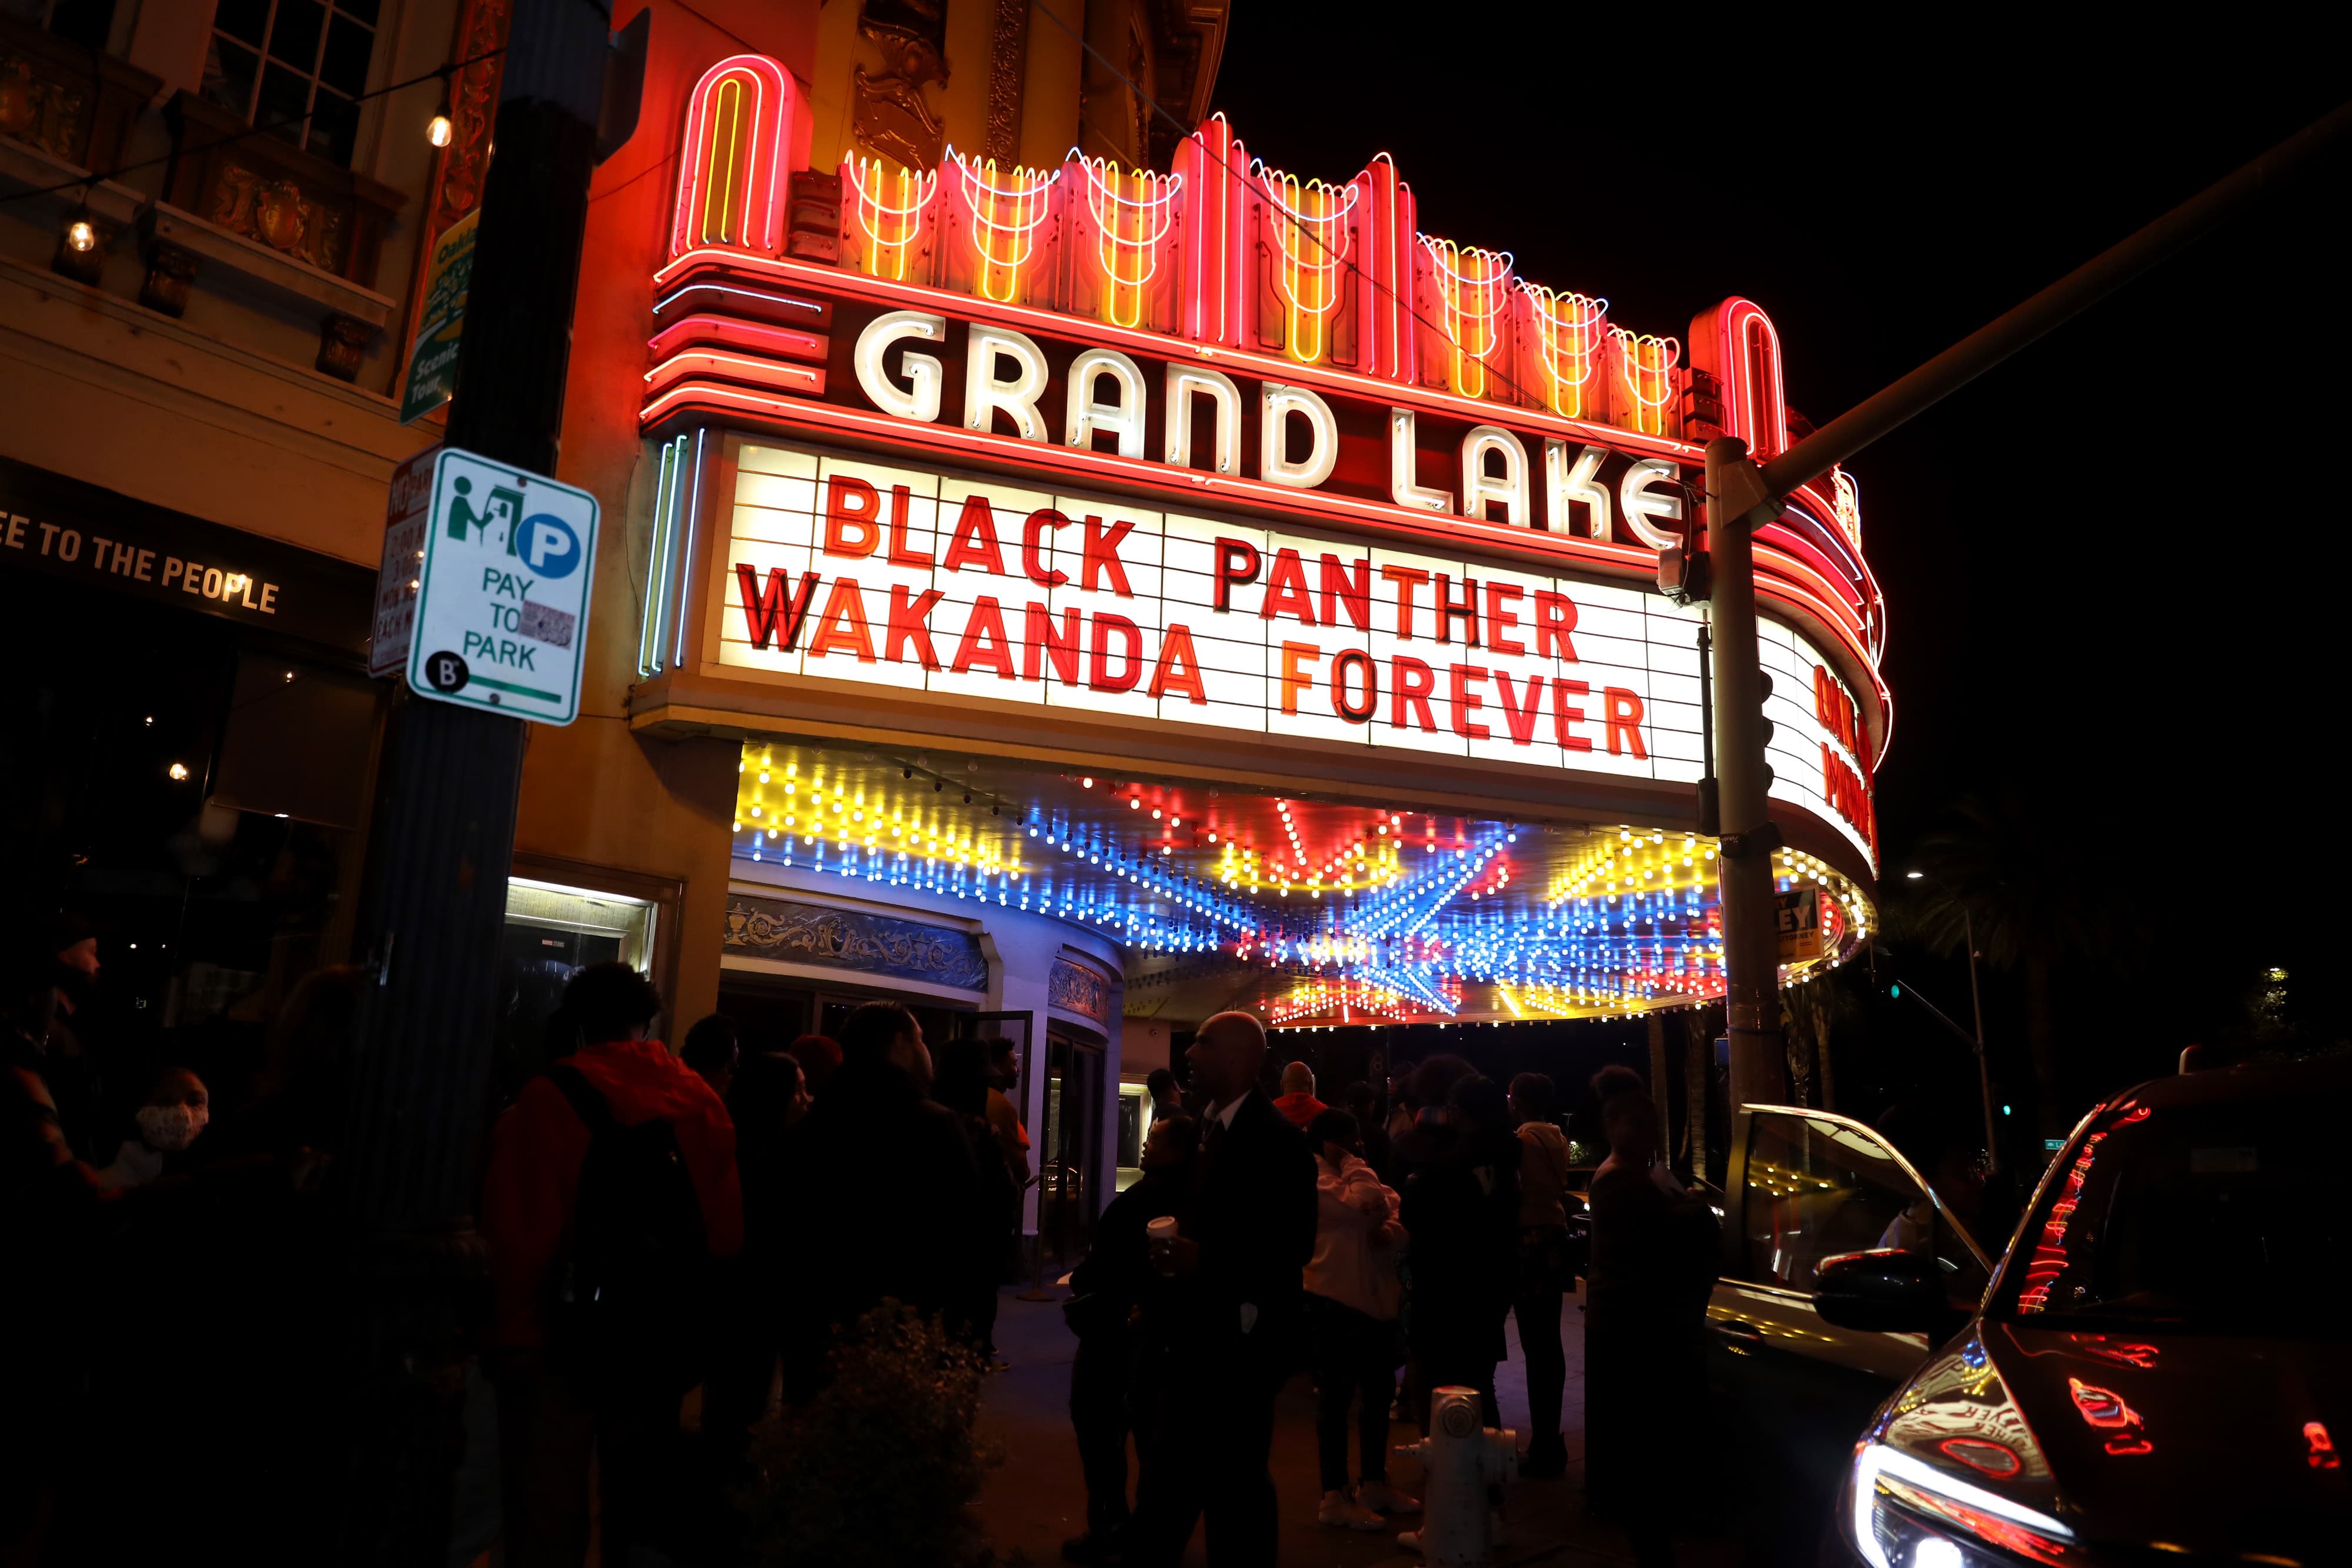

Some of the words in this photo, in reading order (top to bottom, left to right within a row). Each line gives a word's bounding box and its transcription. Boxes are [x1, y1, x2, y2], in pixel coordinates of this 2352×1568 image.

[415, 342, 461, 380] Scenic
[411, 375, 442, 404] Tour
[854, 310, 1338, 487] GRAND
[1391, 406, 1683, 550] LAKE
[530, 521, 572, 569] P
[39, 521, 81, 563] TO
[92, 536, 156, 583] THE
[161, 555, 280, 615] PEOPLE
[482, 567, 534, 601] PAY
[823, 474, 1135, 599] BLACK
[1213, 537, 1579, 664] PANTHER
[490, 603, 520, 633] TO
[463, 630, 537, 671] PARK
[736, 563, 1207, 705] WAKANDA
[1281, 640, 1648, 760] FOREVER
